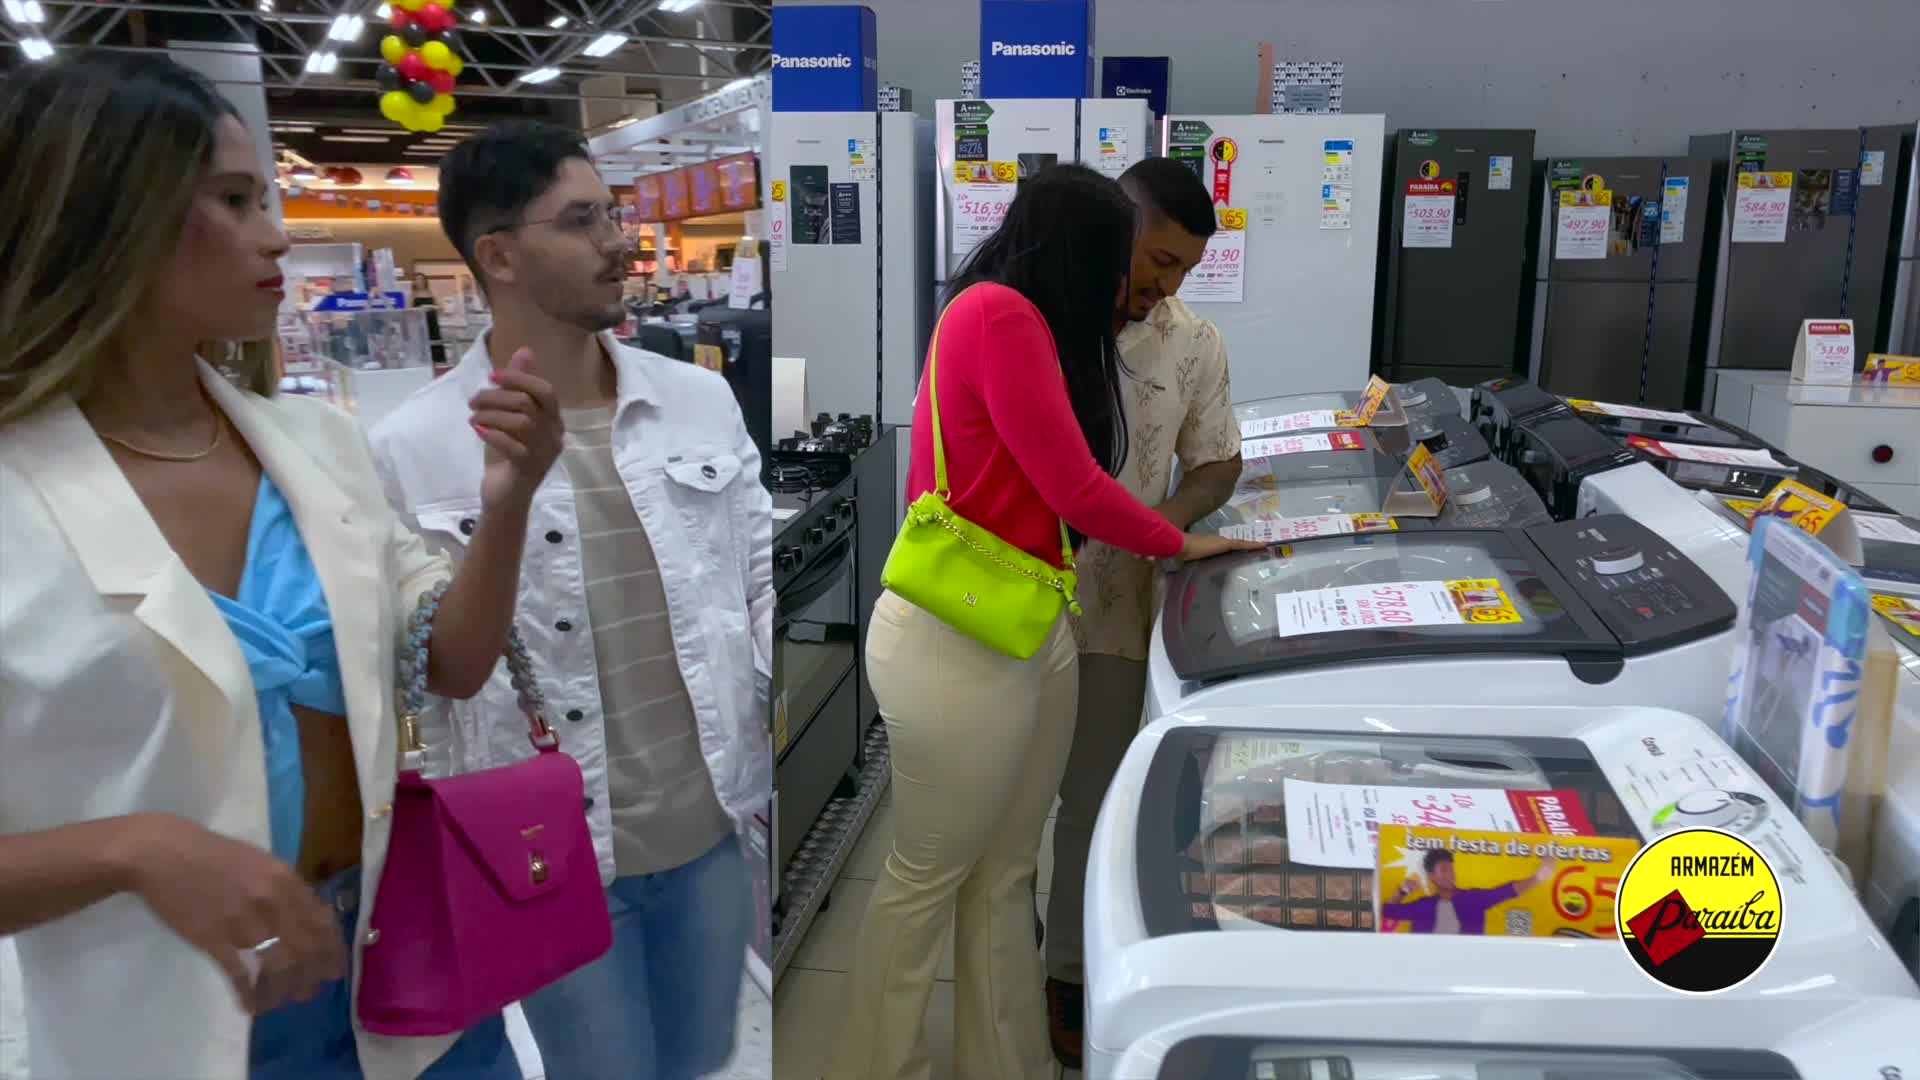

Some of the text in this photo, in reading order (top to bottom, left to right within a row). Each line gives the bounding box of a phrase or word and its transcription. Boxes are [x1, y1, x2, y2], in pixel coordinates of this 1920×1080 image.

[991, 41, 1075, 57] Panasonic
[772, 54, 851, 69] Panasonic
[1406, 832, 1613, 863] tem festa de ofertas
